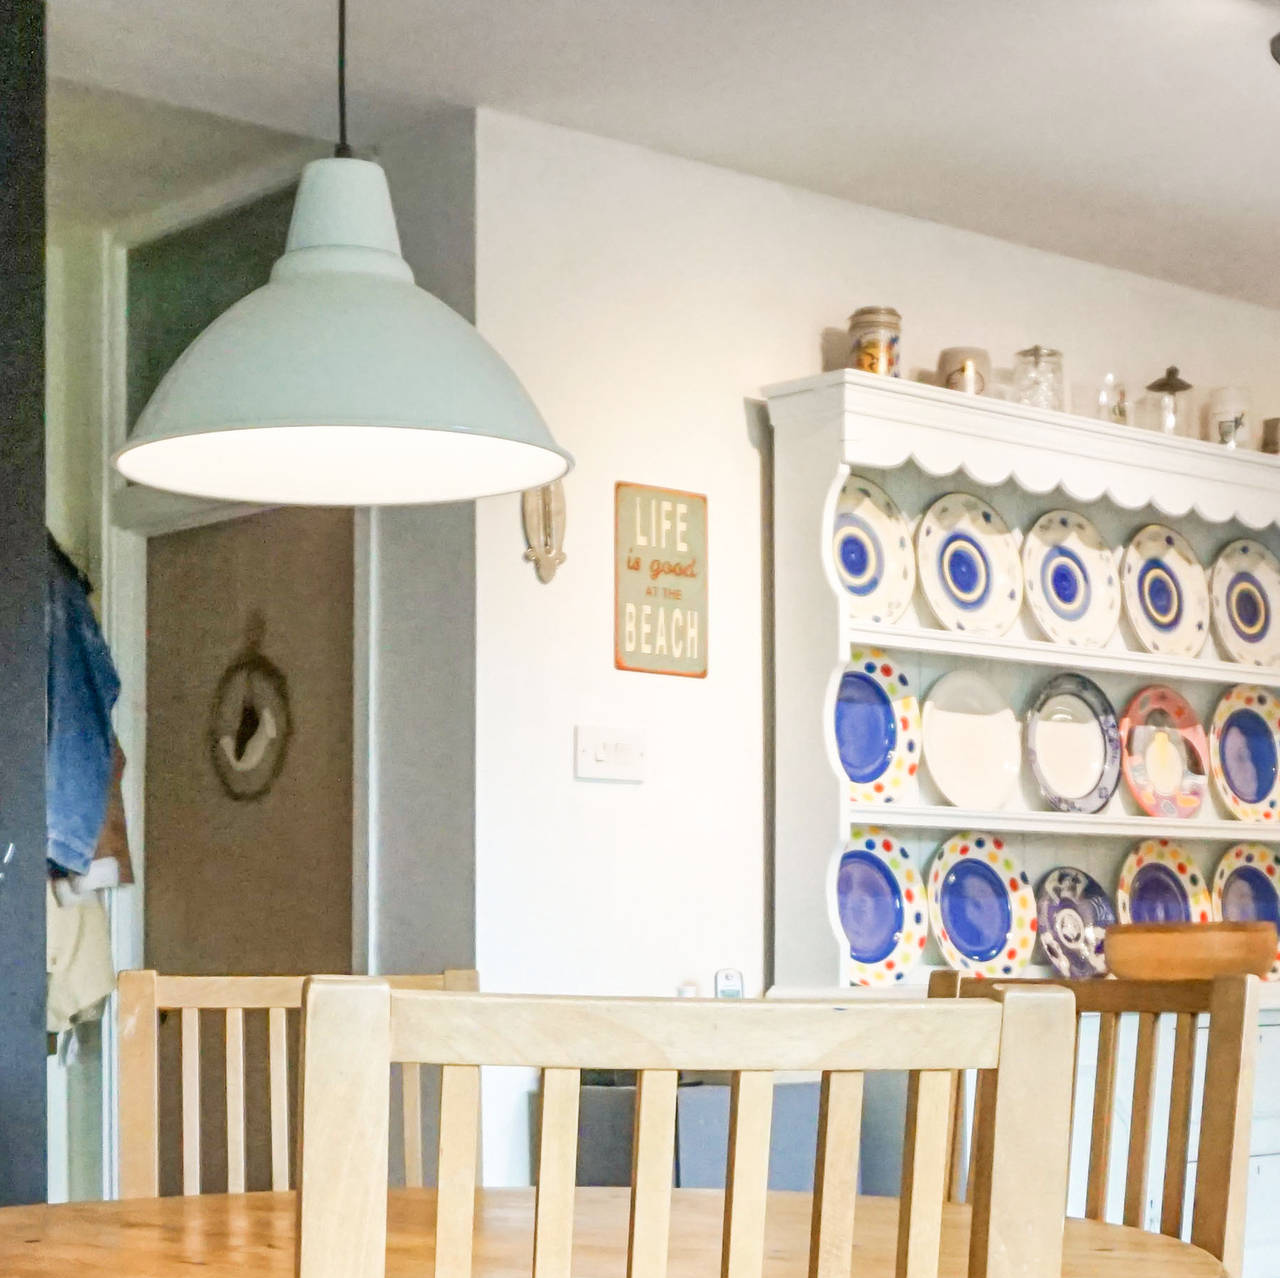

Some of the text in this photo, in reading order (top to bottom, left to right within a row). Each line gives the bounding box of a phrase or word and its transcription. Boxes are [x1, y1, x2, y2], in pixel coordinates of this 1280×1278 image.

[635, 497, 688, 552] LIFE
[627, 548, 696, 580] is good
[646, 586, 682, 600] AT THE
[625, 602, 699, 659] BEACH
